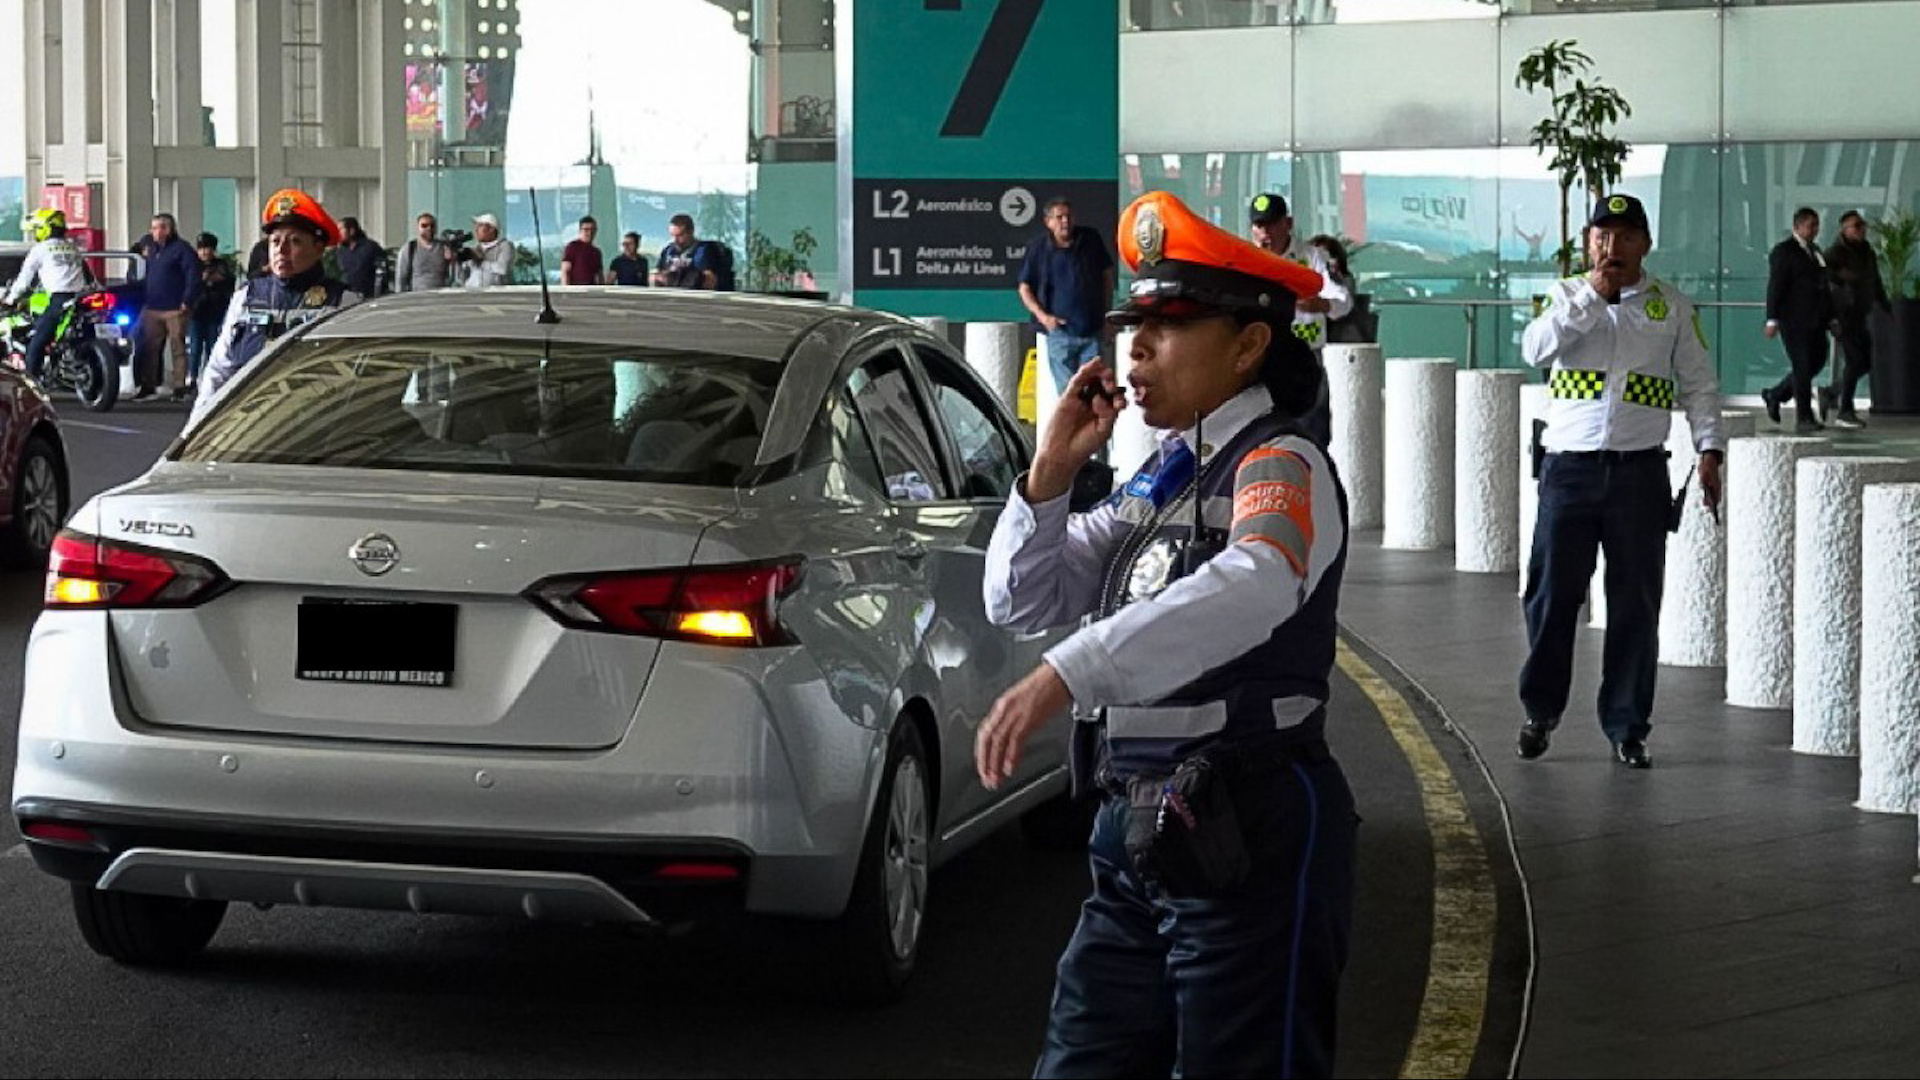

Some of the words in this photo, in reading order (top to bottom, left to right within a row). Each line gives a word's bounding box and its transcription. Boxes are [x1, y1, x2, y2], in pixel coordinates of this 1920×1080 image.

[922, 0, 1045, 136] 7
[873, 189, 910, 218] L2
[916, 198, 993, 212] Aeroméxico
[873, 248, 902, 275] L1
[916, 246, 993, 259] Aeroméxico
[916, 261, 949, 274] Delta
[953, 261, 970, 274] Air
[973, 261, 1006, 275] Lines
